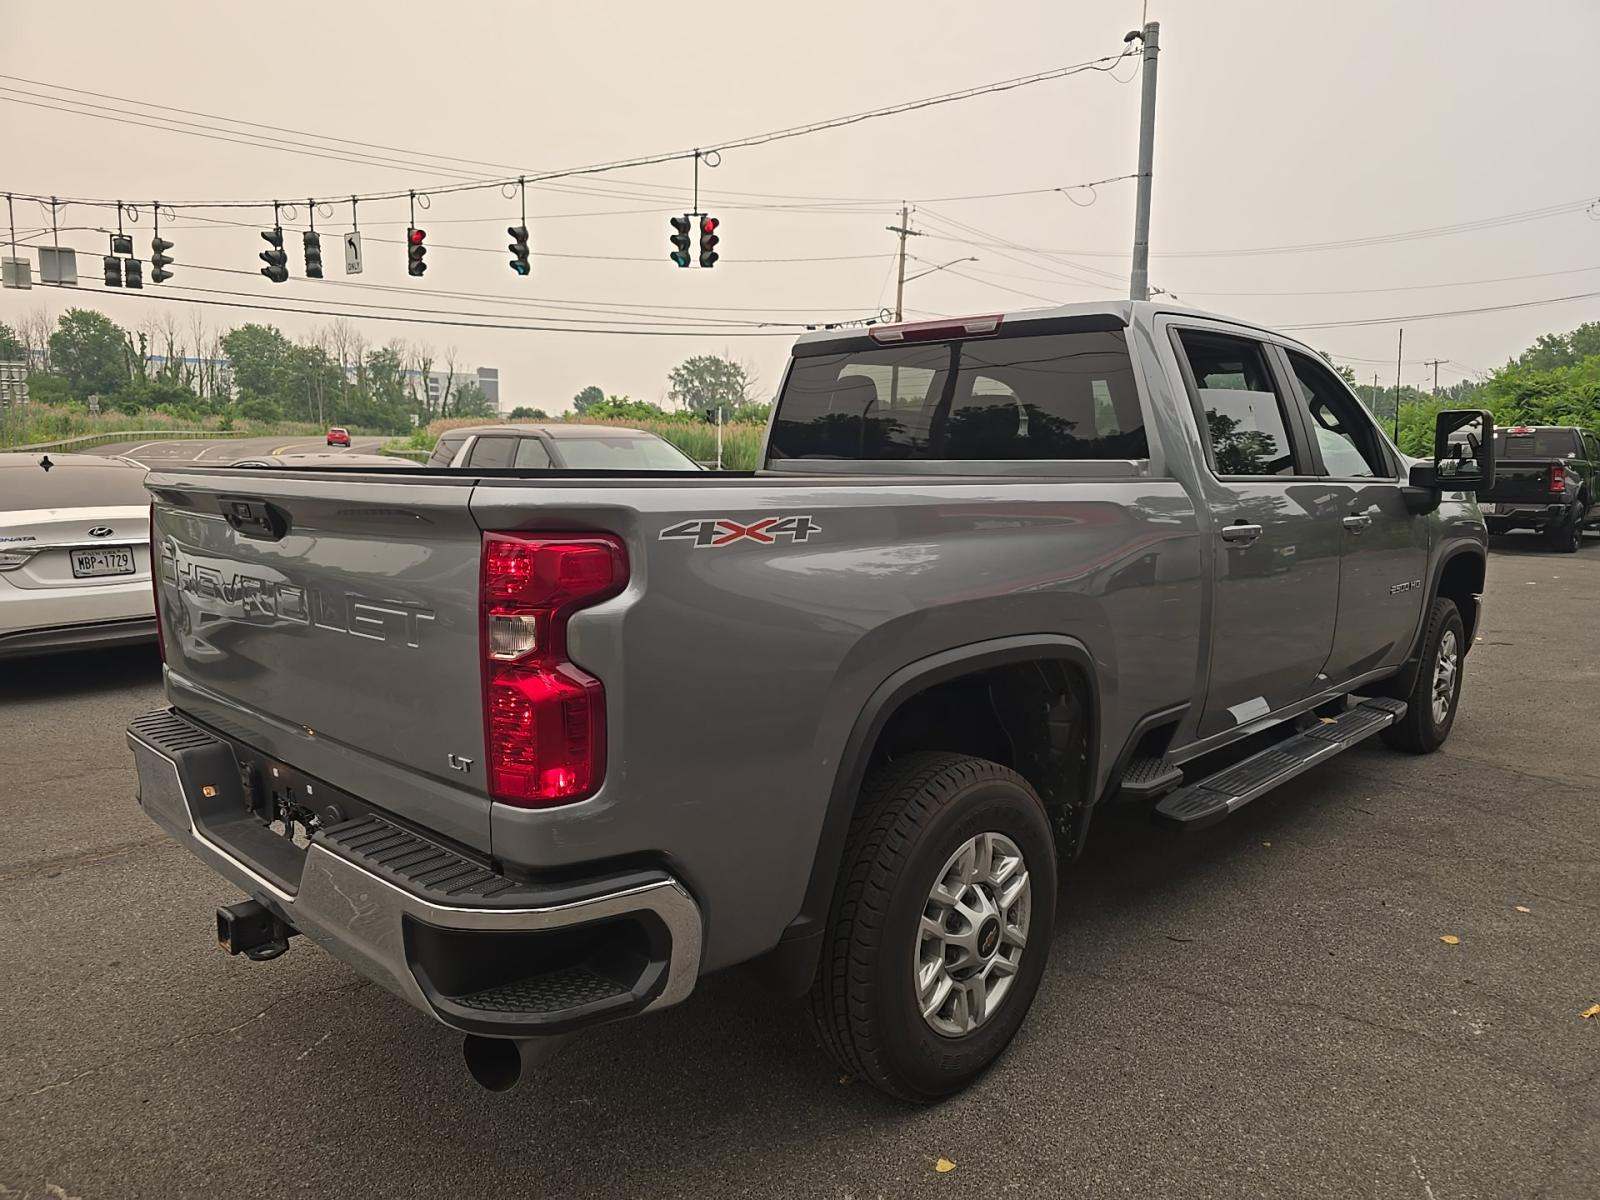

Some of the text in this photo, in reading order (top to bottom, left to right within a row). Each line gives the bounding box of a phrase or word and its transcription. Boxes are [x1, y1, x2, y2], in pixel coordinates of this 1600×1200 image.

[348, 262, 360, 270] ONLY
[104, 554, 128, 568] 1729
[161, 554, 436, 648] CHEVROLET
[448, 753, 474, 772] LT
